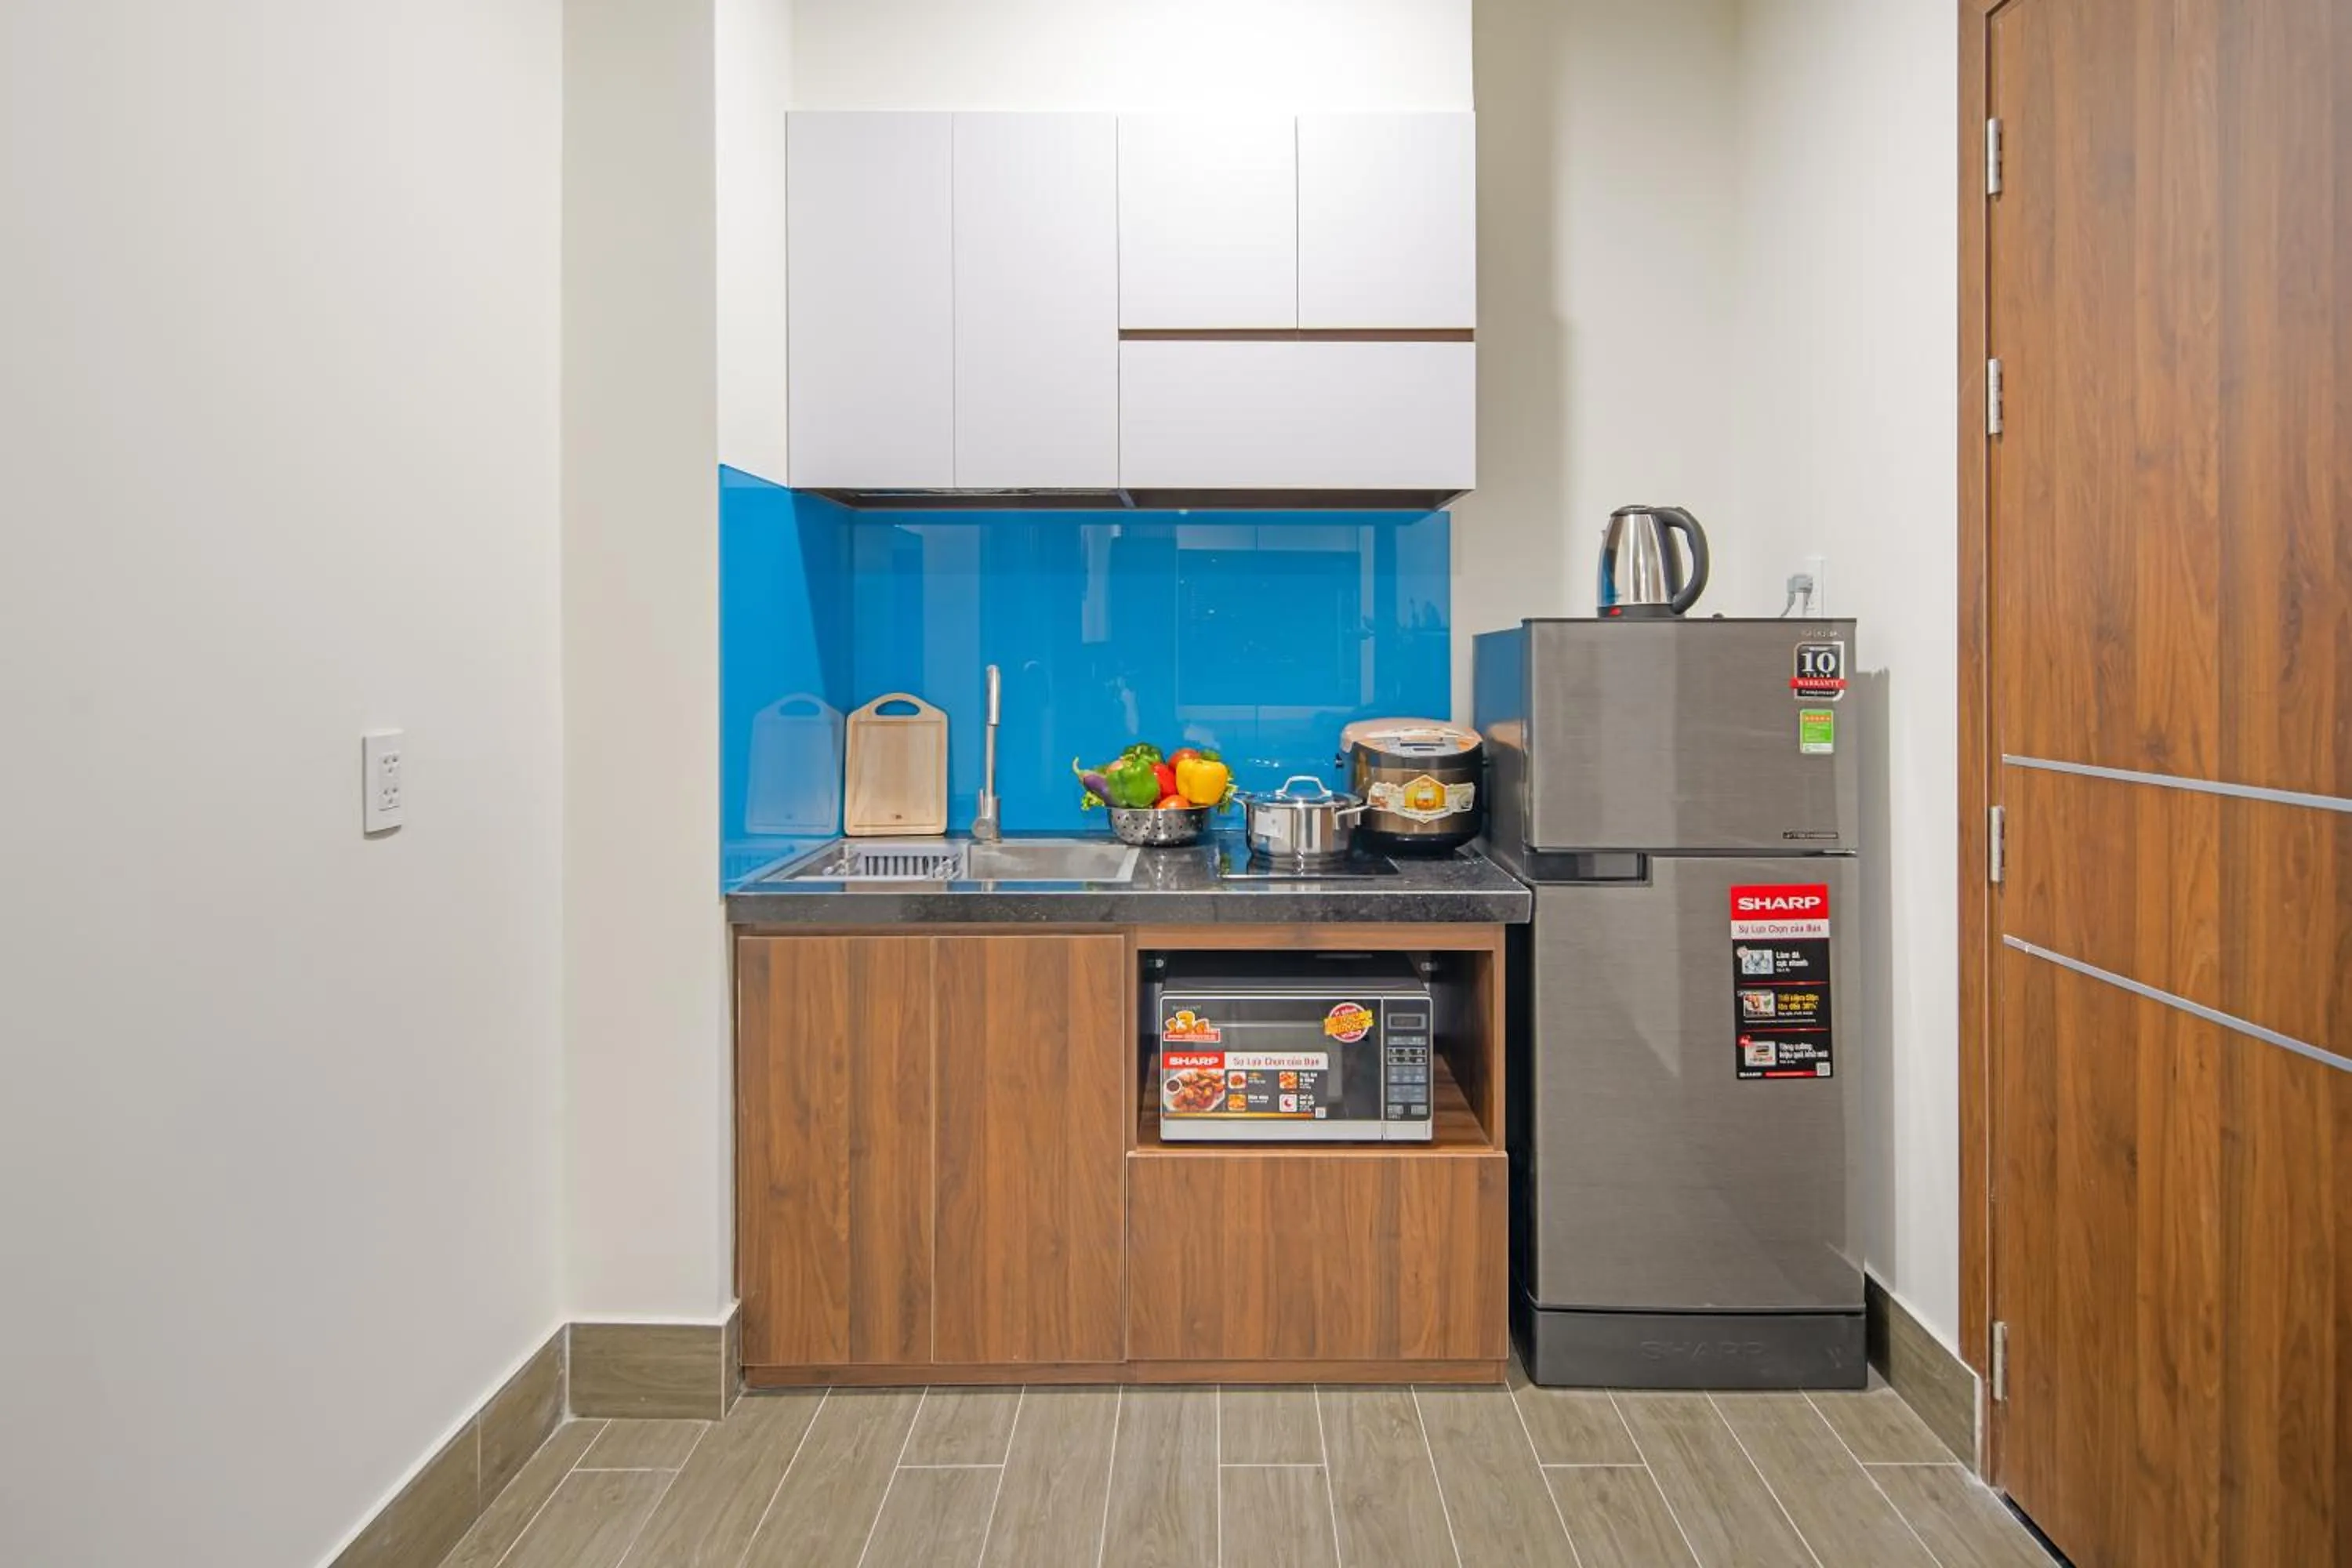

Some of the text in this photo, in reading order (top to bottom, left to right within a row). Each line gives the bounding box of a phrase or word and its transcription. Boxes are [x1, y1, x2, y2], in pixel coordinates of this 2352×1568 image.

[1801, 652, 1836, 673] 10
[1738, 896, 1821, 910] SHARP
[1169, 1056, 1219, 1065] SHARP
